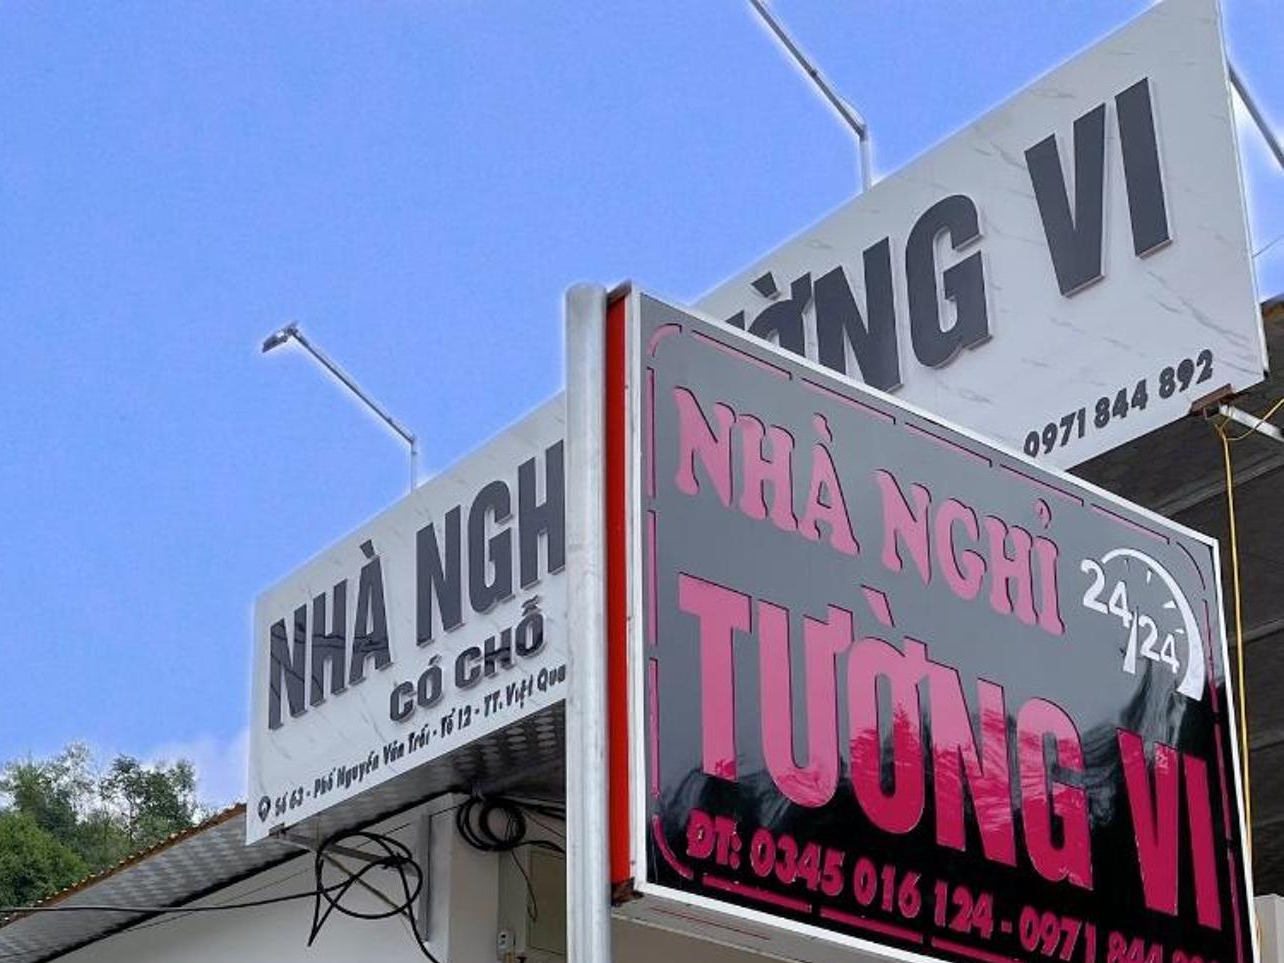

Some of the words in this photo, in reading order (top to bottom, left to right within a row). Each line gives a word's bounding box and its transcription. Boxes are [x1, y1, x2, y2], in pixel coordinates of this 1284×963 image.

[269, 540, 393, 731] NHÀ
[416, 439, 565, 648] NGH
[1024, 77, 1173, 298] VI
[1023, 407, 1086, 458] 0971
[1094, 379, 1149, 429] 844
[1159, 349, 1214, 399] 892
[673, 385, 860, 558] NHÀ
[875, 468, 1066, 636] NGHỈ
[390, 655, 444, 722] CÓ
[455, 595, 547, 690] CHỖ
[314, 767, 336, 798] Phố
[458, 705, 471, 730] 12
[537, 664, 565, 692] Qua
[678, 571, 1093, 890] TƯỜNG
[1117, 727, 1222, 931] VI
[750, 827, 846, 897] 0345
[853, 857, 922, 919] 016
[934, 879, 994, 939] 124
